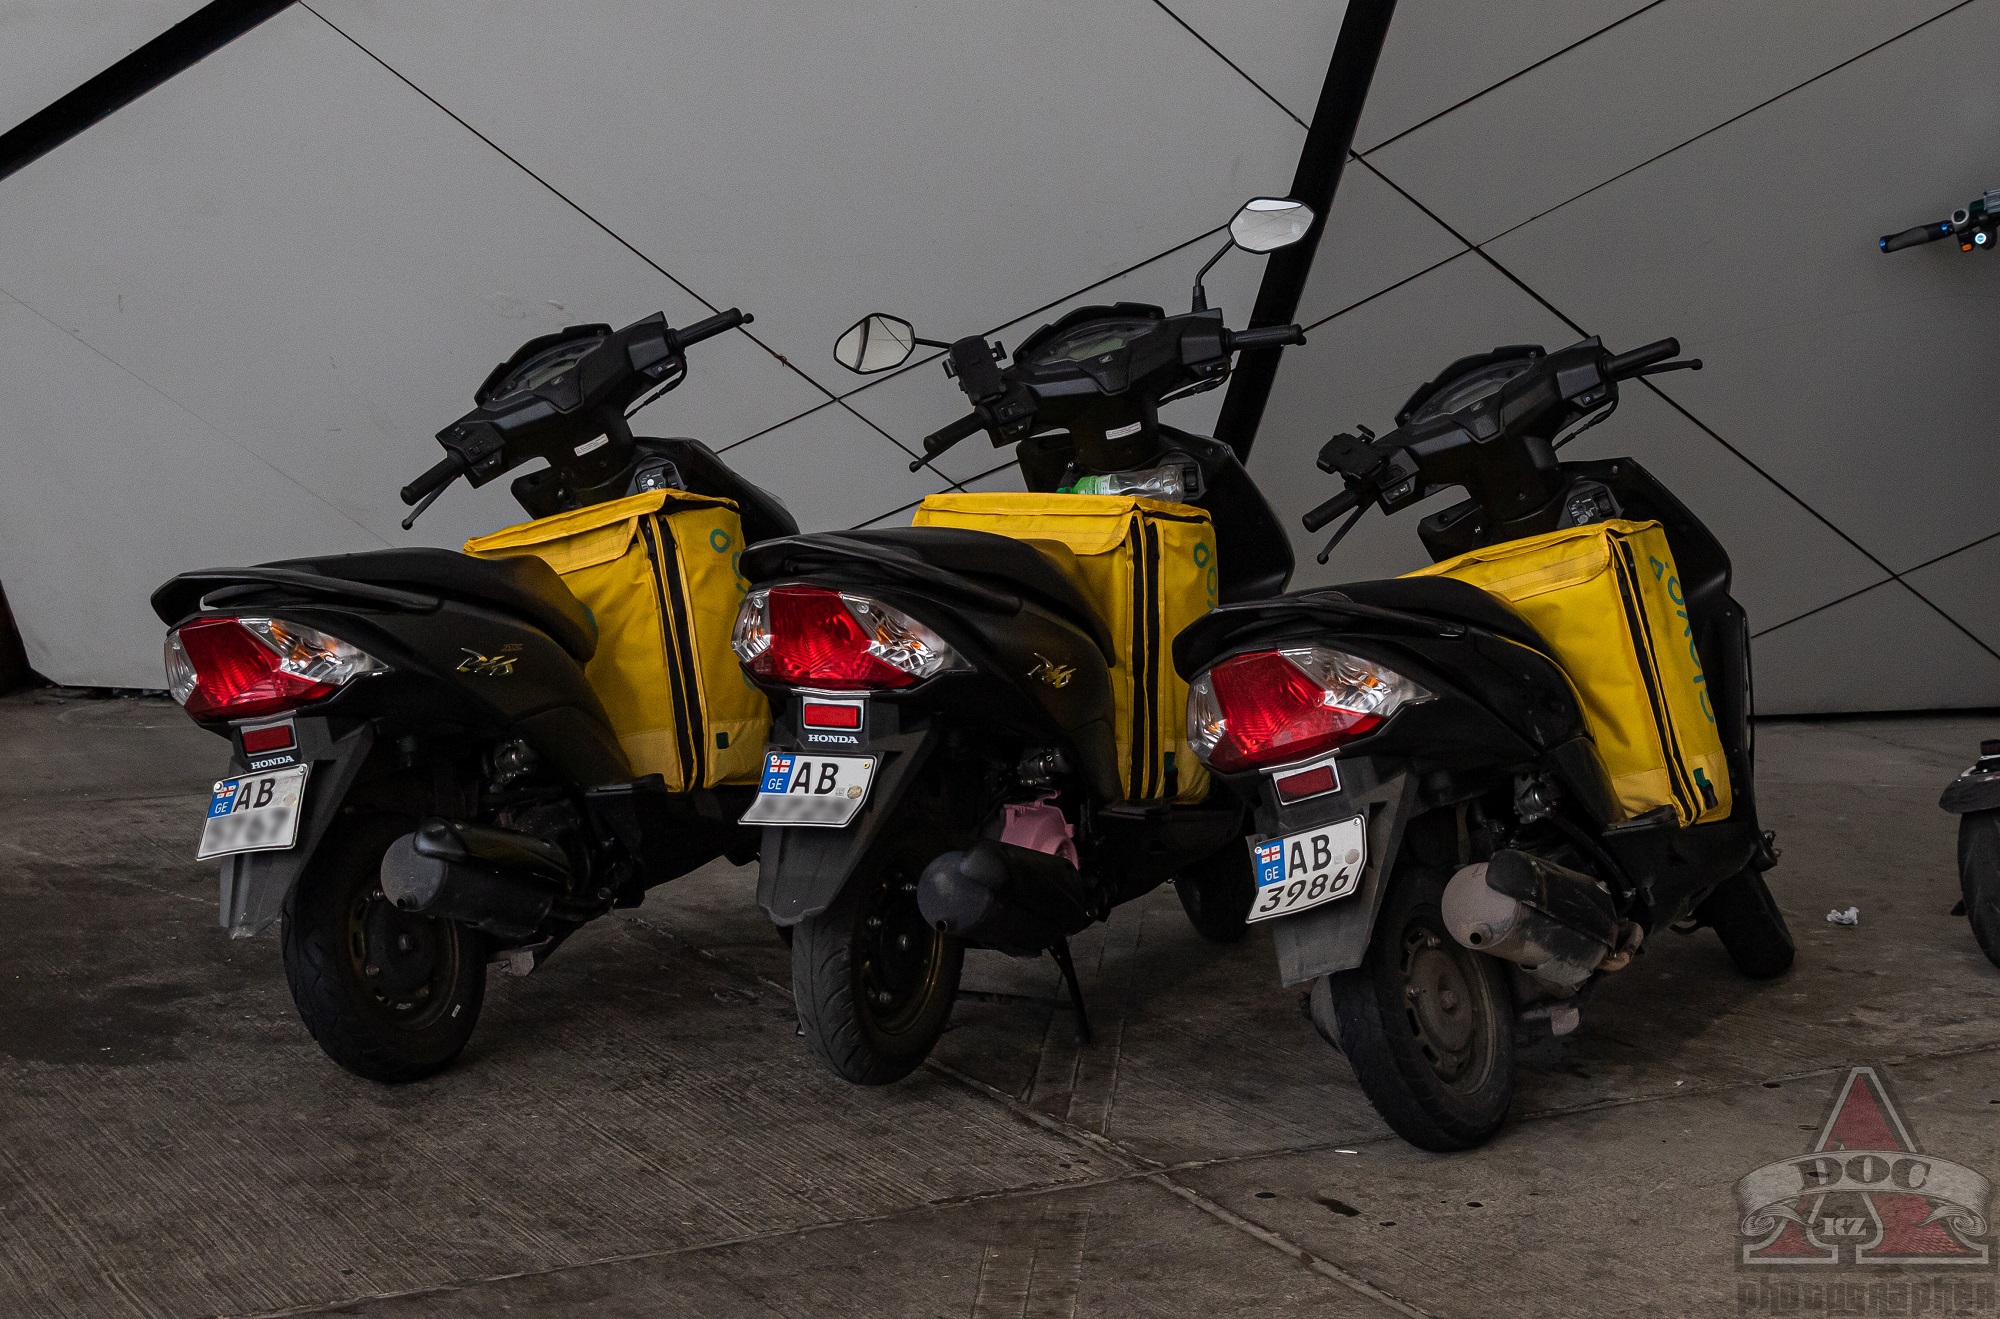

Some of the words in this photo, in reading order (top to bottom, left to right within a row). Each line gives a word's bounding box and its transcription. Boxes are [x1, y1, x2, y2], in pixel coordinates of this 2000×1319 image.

[808, 734, 859, 744] HONDA
[251, 755, 294, 770] HONDA
[767, 778, 784, 790] GE
[790, 761, 839, 794] AB
[232, 778, 276, 813] AB
[214, 802, 228, 813] GE
[1288, 834, 1333, 879] AB
[1264, 866, 1280, 881] GE
[1259, 866, 1351, 913] 3986
